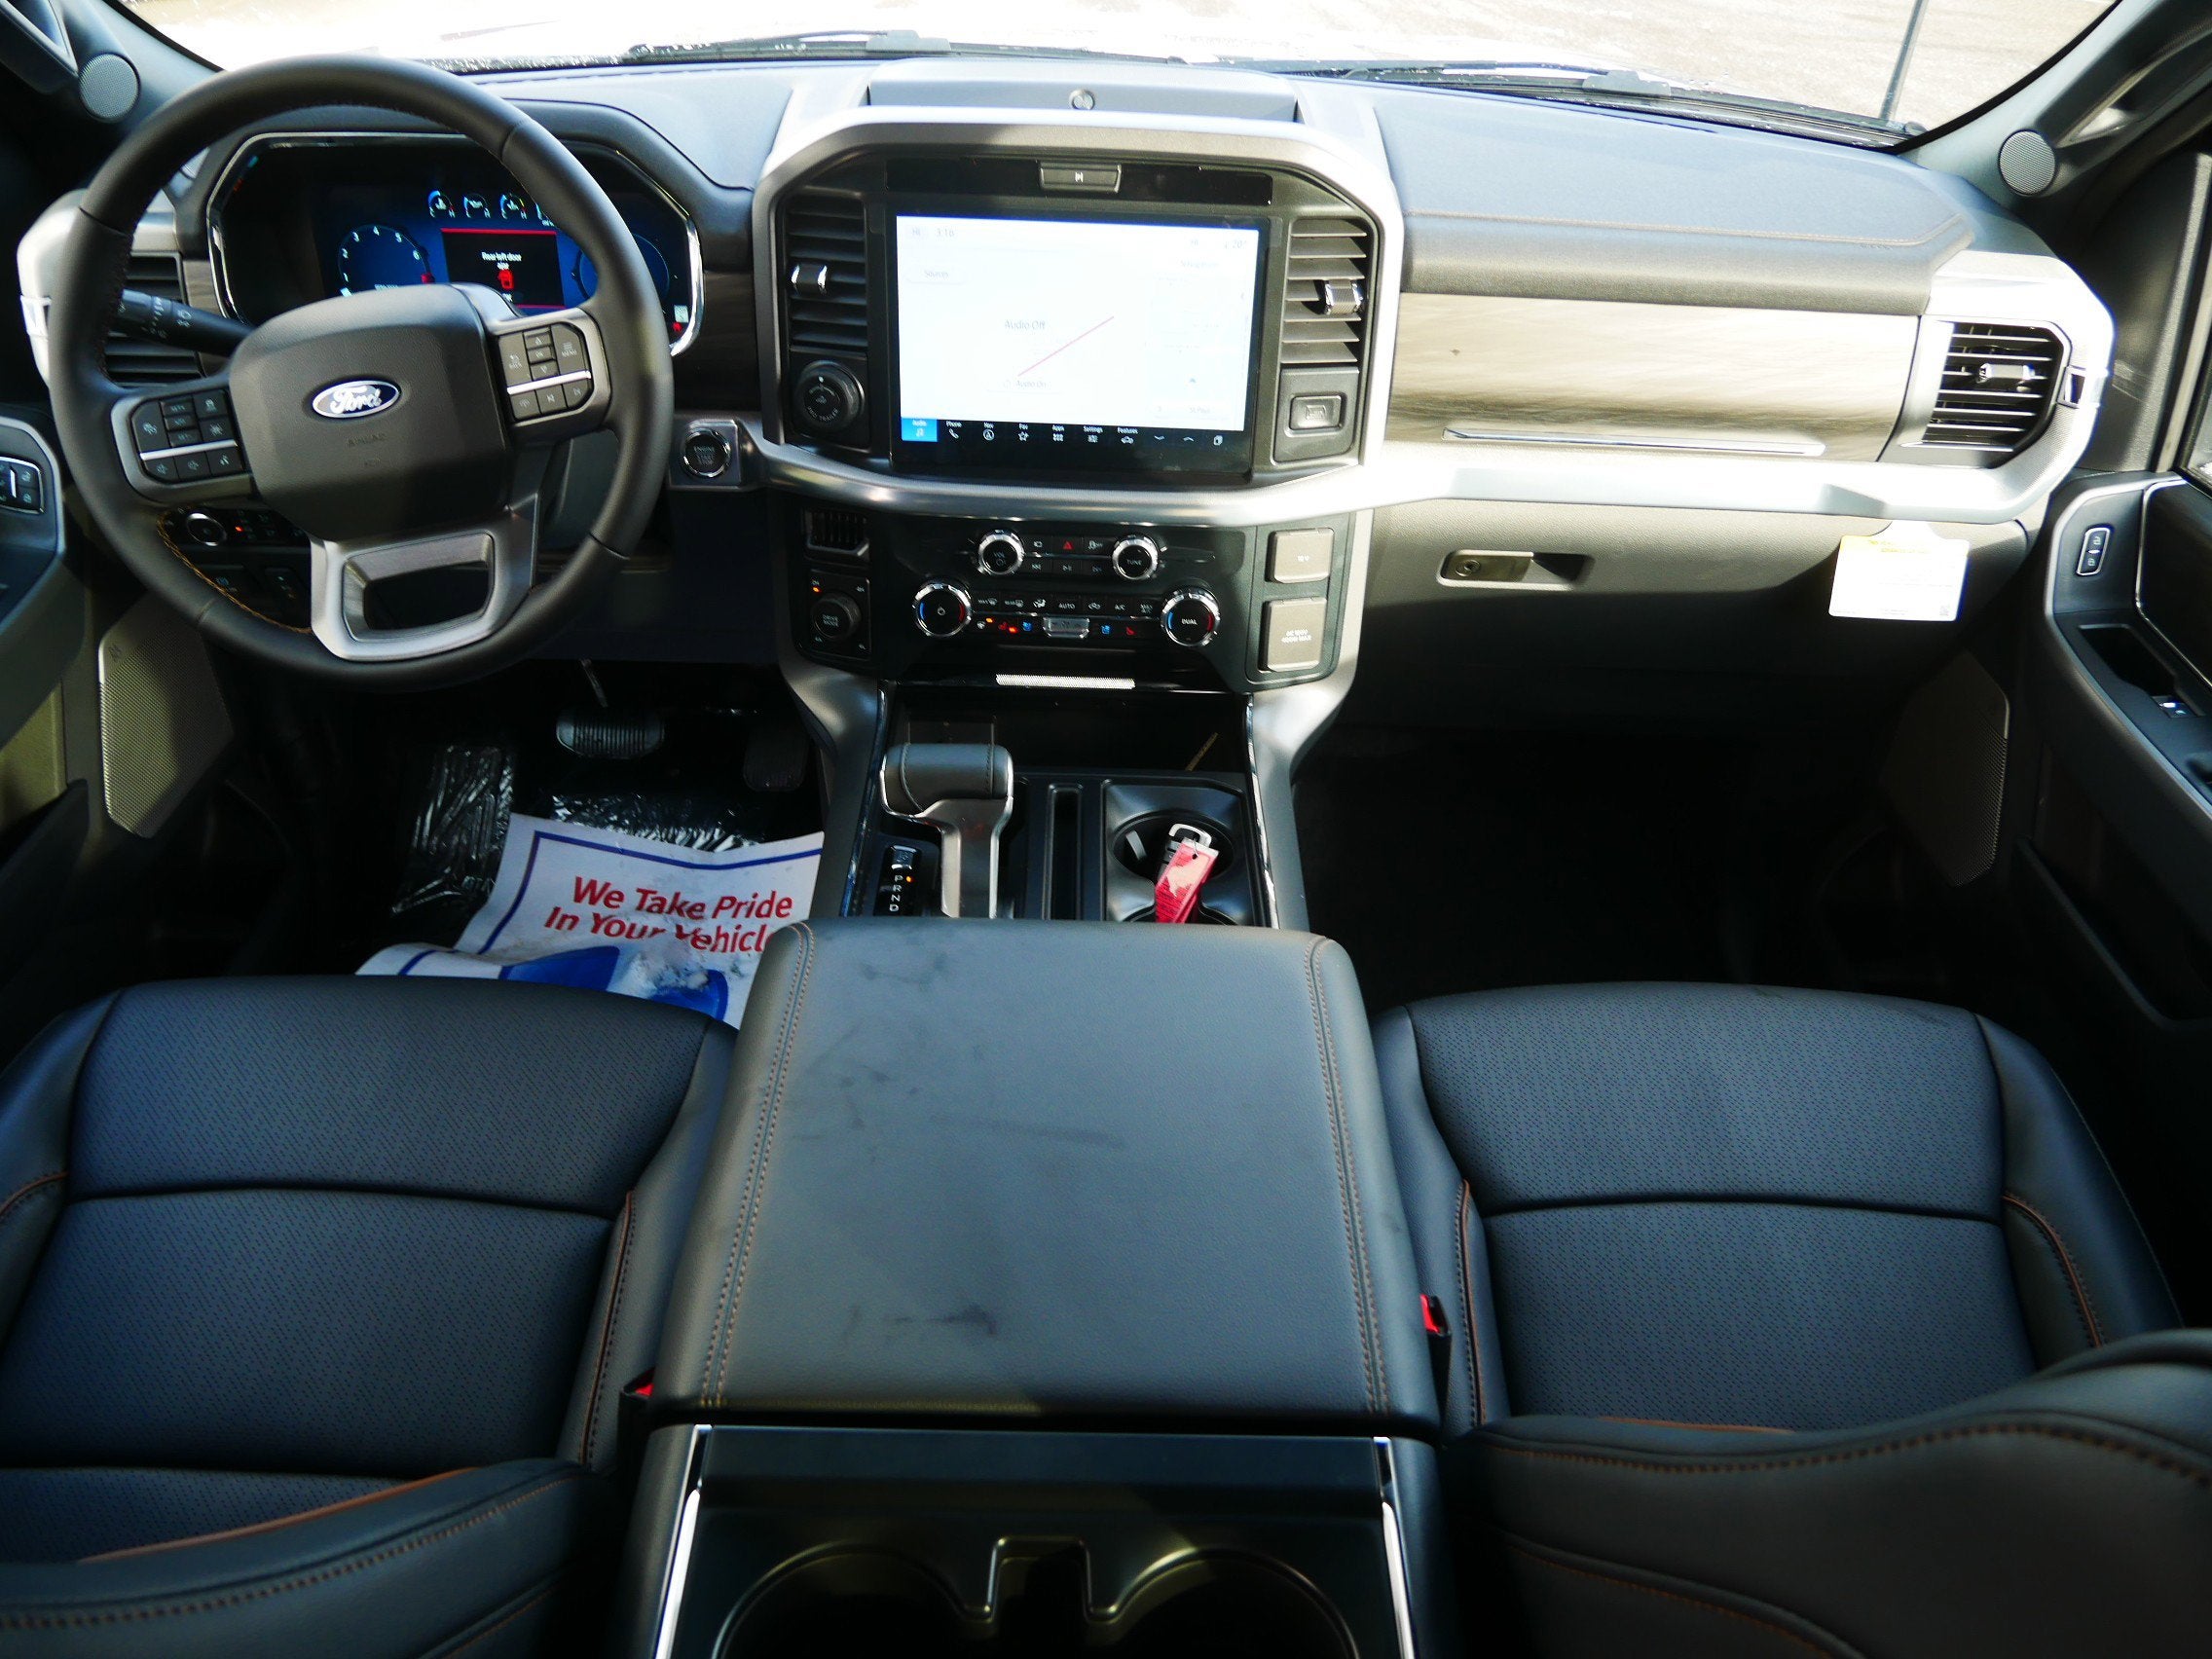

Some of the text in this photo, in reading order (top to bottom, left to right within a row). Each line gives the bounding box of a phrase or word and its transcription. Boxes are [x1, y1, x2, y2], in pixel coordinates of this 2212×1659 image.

[507, 252, 522, 262] door
[1004, 319, 1046, 330] Audio Off
[330, 386, 382, 414] Ford
[573, 876, 793, 921] We Take Pride
[891, 894, 901, 903] N
[544, 906, 579, 931] In
[589, 912, 666, 940] Your
